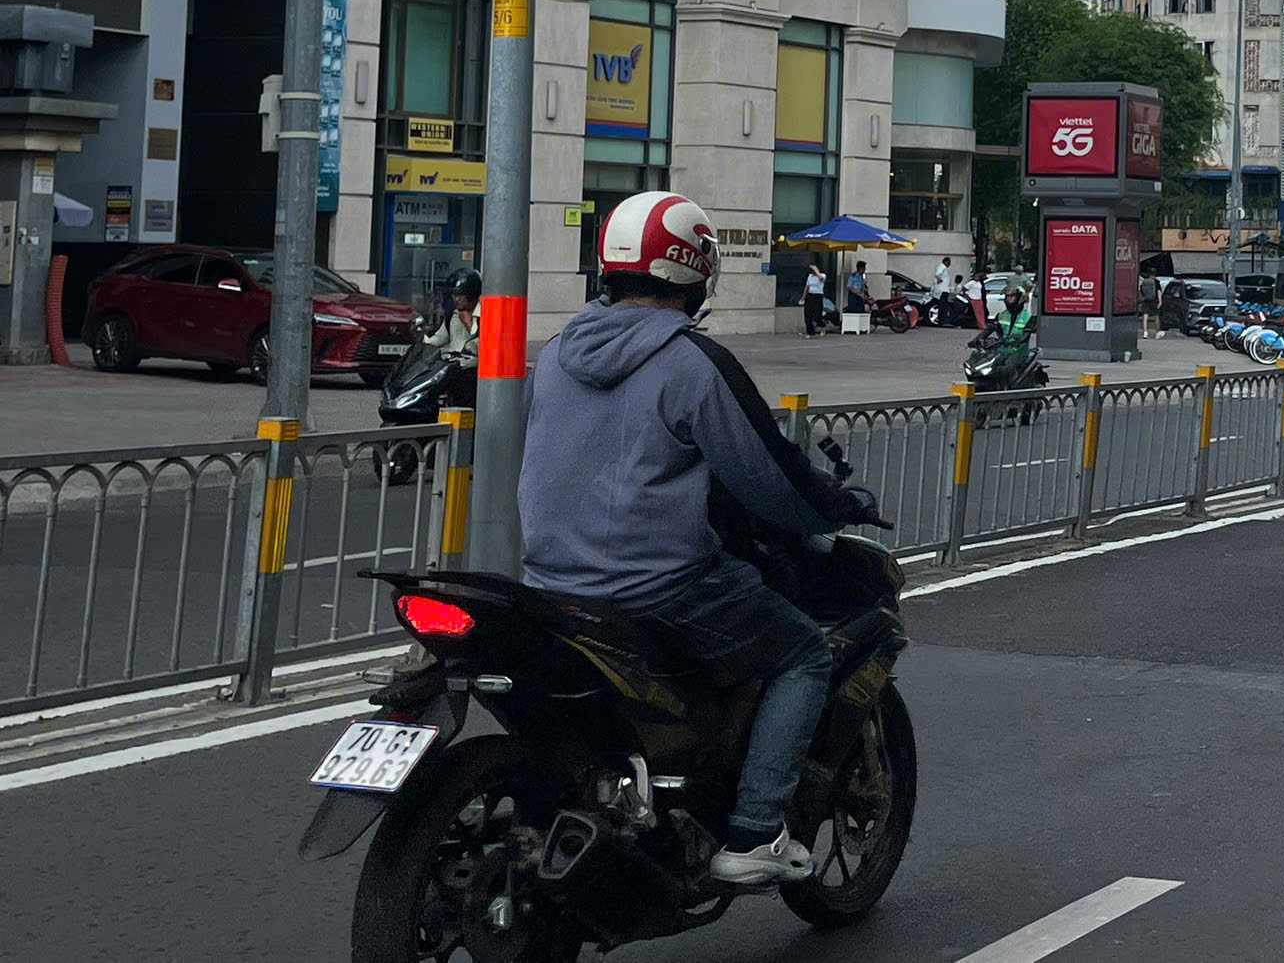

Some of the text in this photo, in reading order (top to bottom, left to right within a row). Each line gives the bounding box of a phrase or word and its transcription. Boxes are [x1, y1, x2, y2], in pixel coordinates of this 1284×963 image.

[1059, 116, 1094, 126] viettel
[411, 123, 446, 132] WESTERN
[421, 131, 446, 139] UNION
[1051, 128, 1094, 157] 5G
[1132, 133, 1156, 157] GIGA
[395, 201, 420, 215] ATM
[1071, 225, 1098, 233] DATA
[1050, 276, 1080, 290] 300
